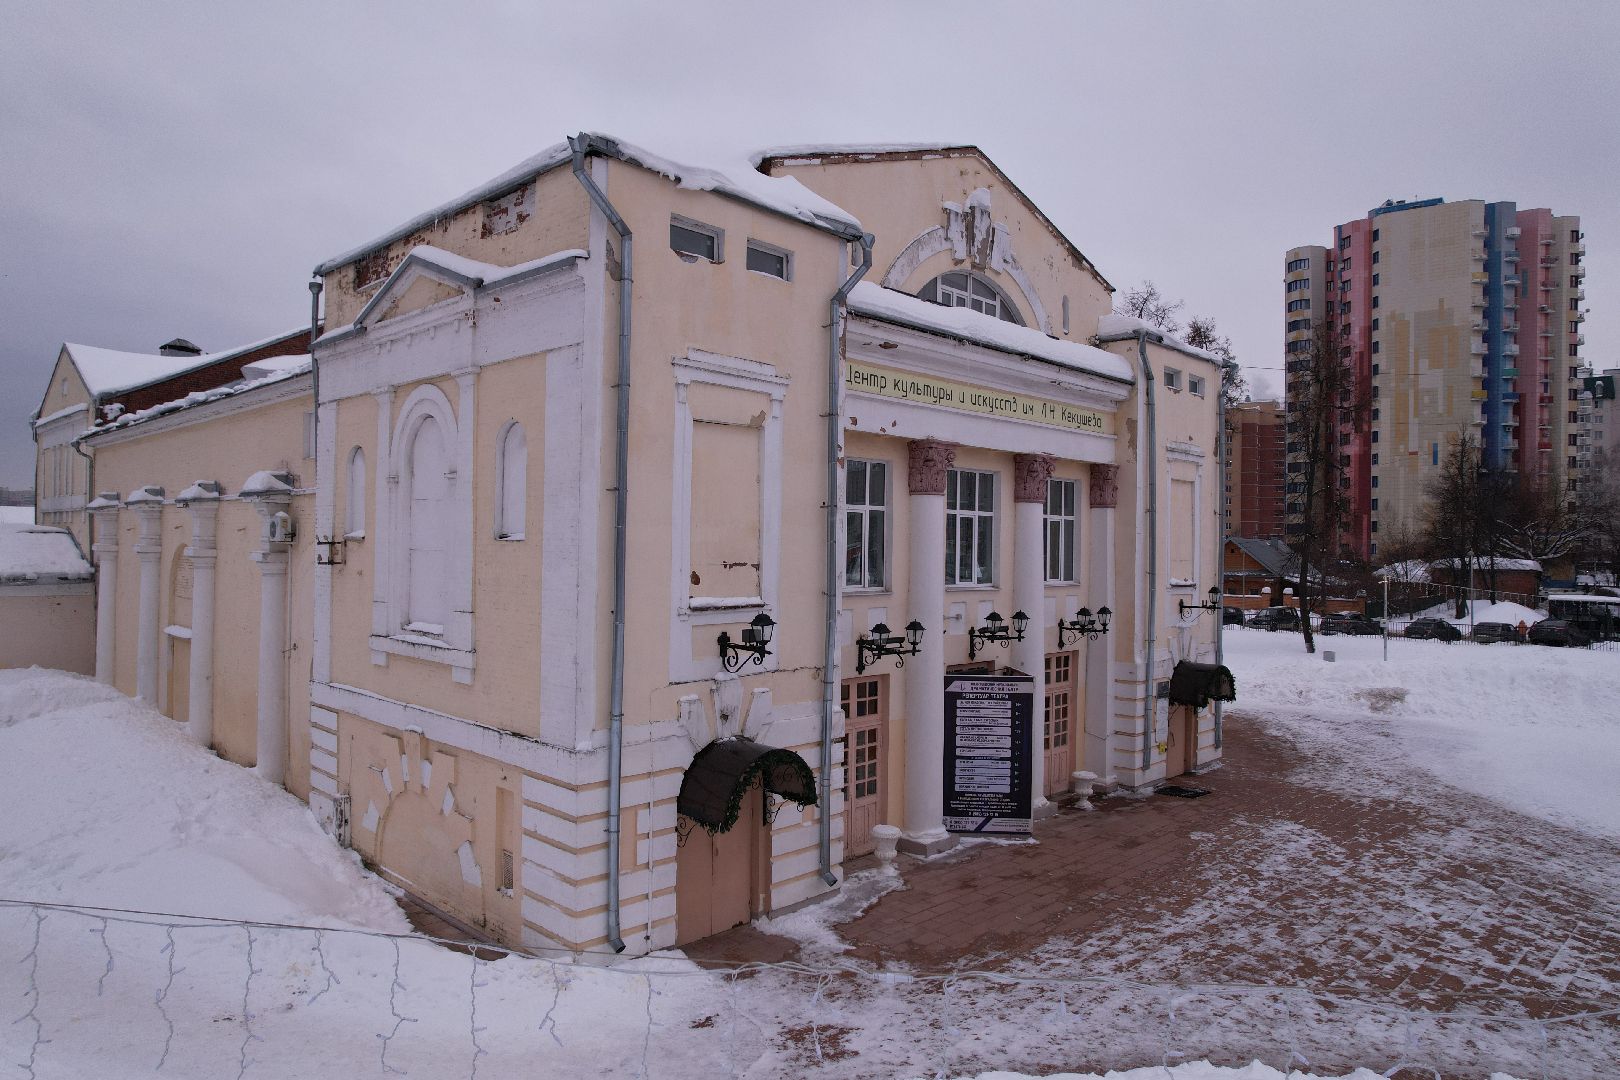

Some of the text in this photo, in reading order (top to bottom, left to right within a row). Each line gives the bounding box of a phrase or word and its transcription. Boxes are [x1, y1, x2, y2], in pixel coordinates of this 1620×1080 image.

[893, 378, 953, 403] культуры
[959, 391, 965, 404] и
[970, 393, 1017, 412] искусств
[1061, 406, 1102, 429] Кекушева
